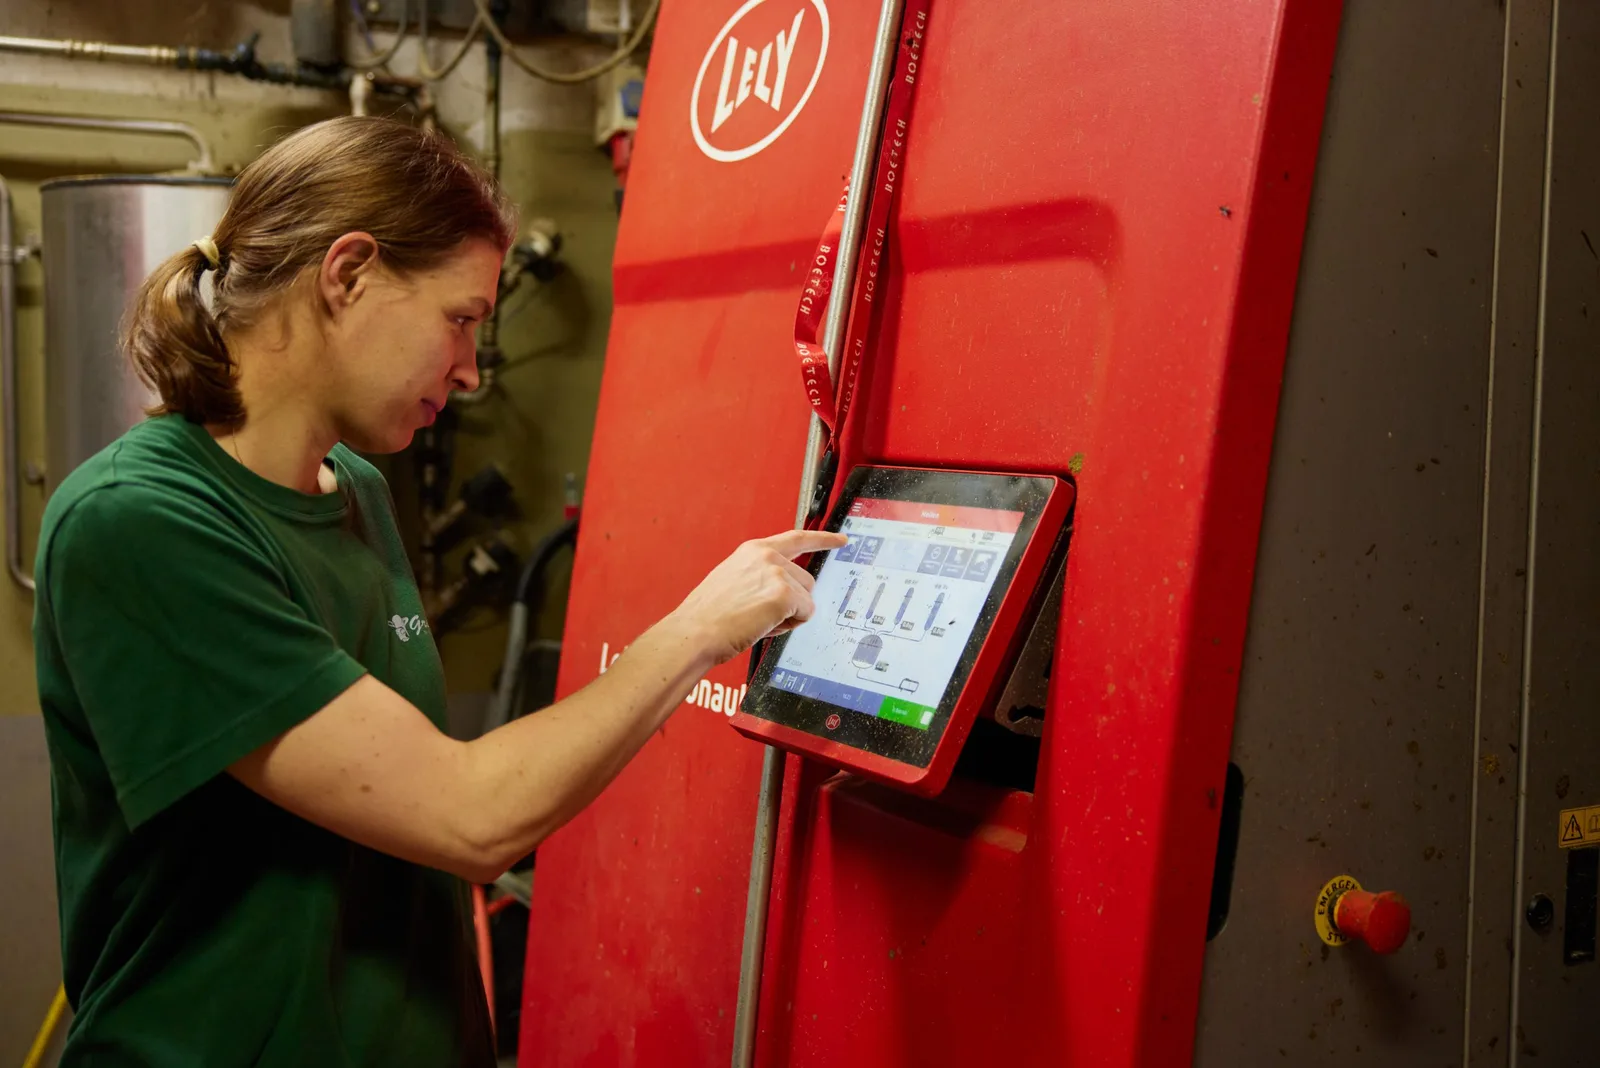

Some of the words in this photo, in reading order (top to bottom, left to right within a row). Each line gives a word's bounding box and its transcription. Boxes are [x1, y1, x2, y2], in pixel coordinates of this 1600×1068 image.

[711, 8, 805, 133] LELY
[905, 11, 926, 84] BOETECH
[884, 119, 906, 193] BOETECH
[800, 245, 831, 314] BOETECH
[865, 228, 884, 302] BOETECH
[796, 342, 821, 406] BOETECH
[843, 339, 863, 412] BOETECH
[1318, 880, 1358, 915] EMERGEN
